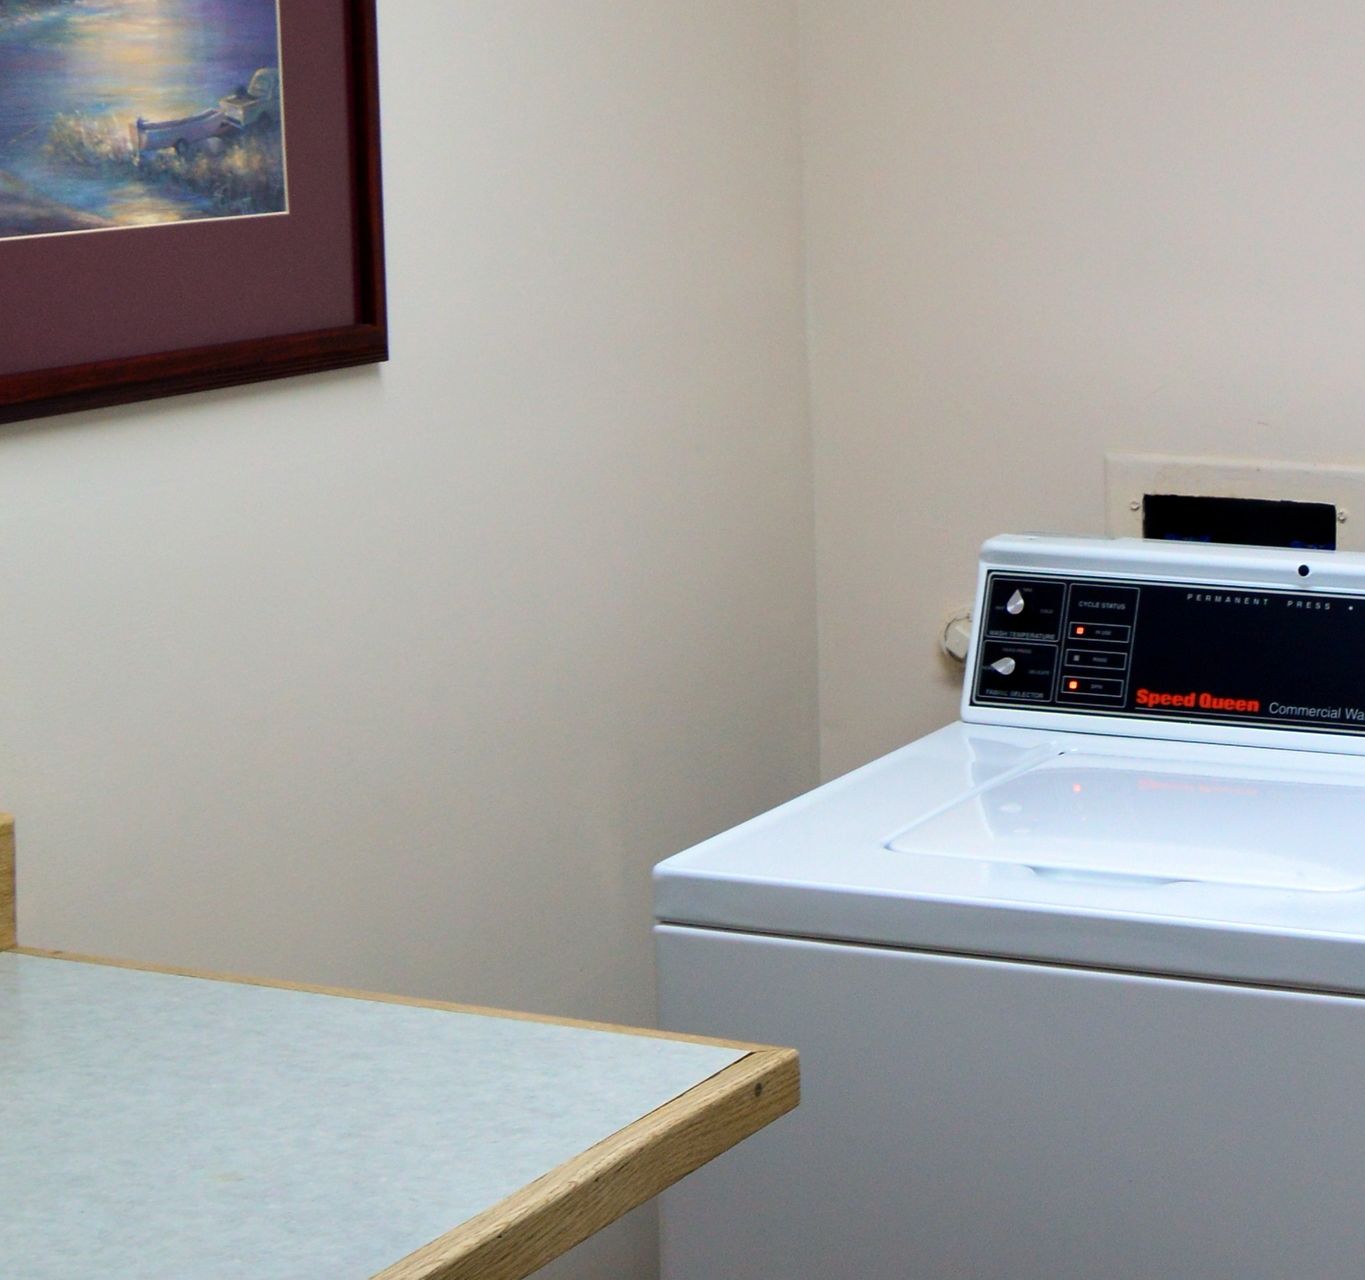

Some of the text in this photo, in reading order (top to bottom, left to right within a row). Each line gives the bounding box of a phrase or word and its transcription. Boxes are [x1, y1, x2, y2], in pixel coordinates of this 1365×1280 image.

[1187, 593, 1269, 606] PERMANENT
[1287, 600, 1332, 610] PRESS
[1137, 688, 1196, 708] Speed
[1199, 694, 1260, 713] Queen
[1269, 702, 1341, 719] Commercial
